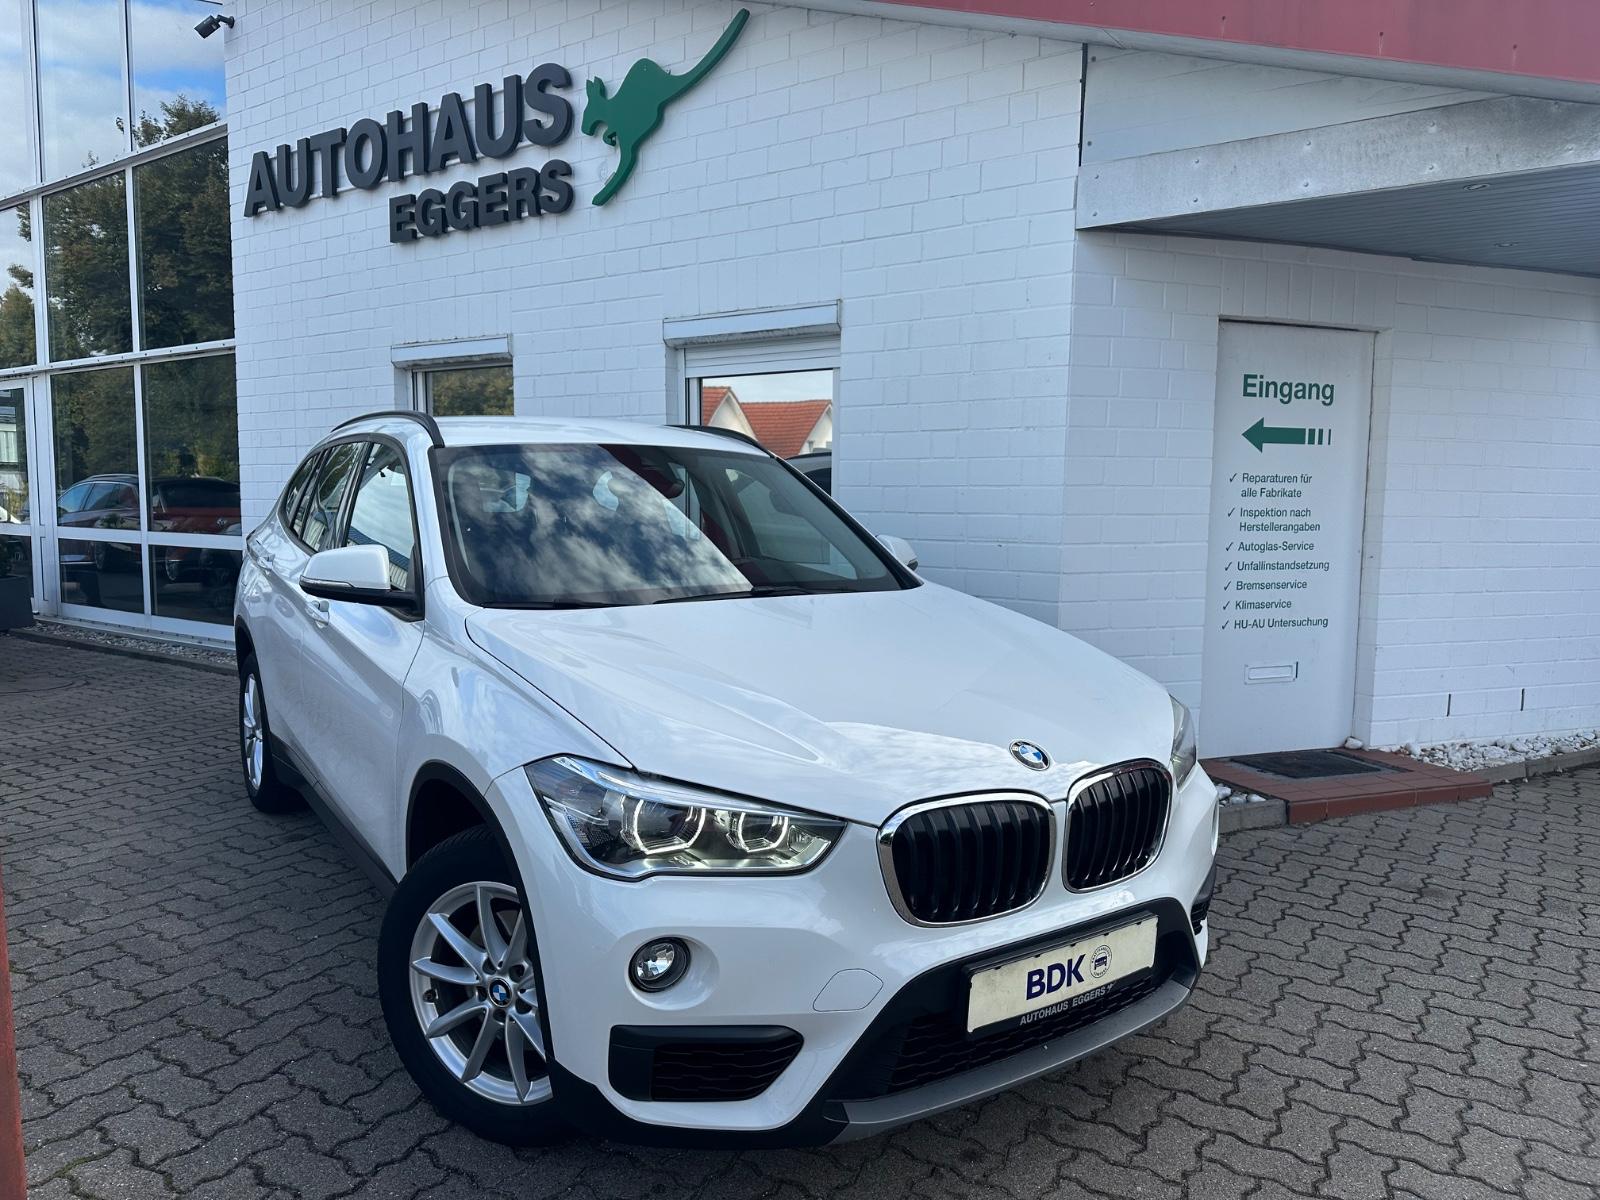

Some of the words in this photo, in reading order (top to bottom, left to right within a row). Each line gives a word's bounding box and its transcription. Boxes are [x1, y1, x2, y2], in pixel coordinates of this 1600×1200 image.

[243, 62, 573, 217] AUTOHAUS
[389, 158, 574, 244] EGGERS
[1242, 373, 1335, 407] Eingang
[1242, 472, 1298, 485] Reparaturen
[1300, 473, 1312, 484] für
[1240, 487, 1258, 498] alle
[1259, 487, 1302, 498] Fabrikate
[1240, 507, 1288, 519] Inspektion
[1289, 507, 1312, 517] nach
[1239, 521, 1321, 534] Herstellerangaben
[1237, 540, 1315, 554] Autoglas-Service
[1237, 560, 1330, 572] Unfallinstandsetzung
[1236, 579, 1308, 591] Bremsenservice
[1235, 598, 1292, 610] Klimaservice
[1233, 619, 1266, 630] HU-AU
[1266, 617, 1329, 629] Untersuchung
[1026, 954, 1086, 1000] BDK
[1020, 1001, 1069, 1025] AUTOHAUS
[1072, 986, 1106, 1007] EGGERS
